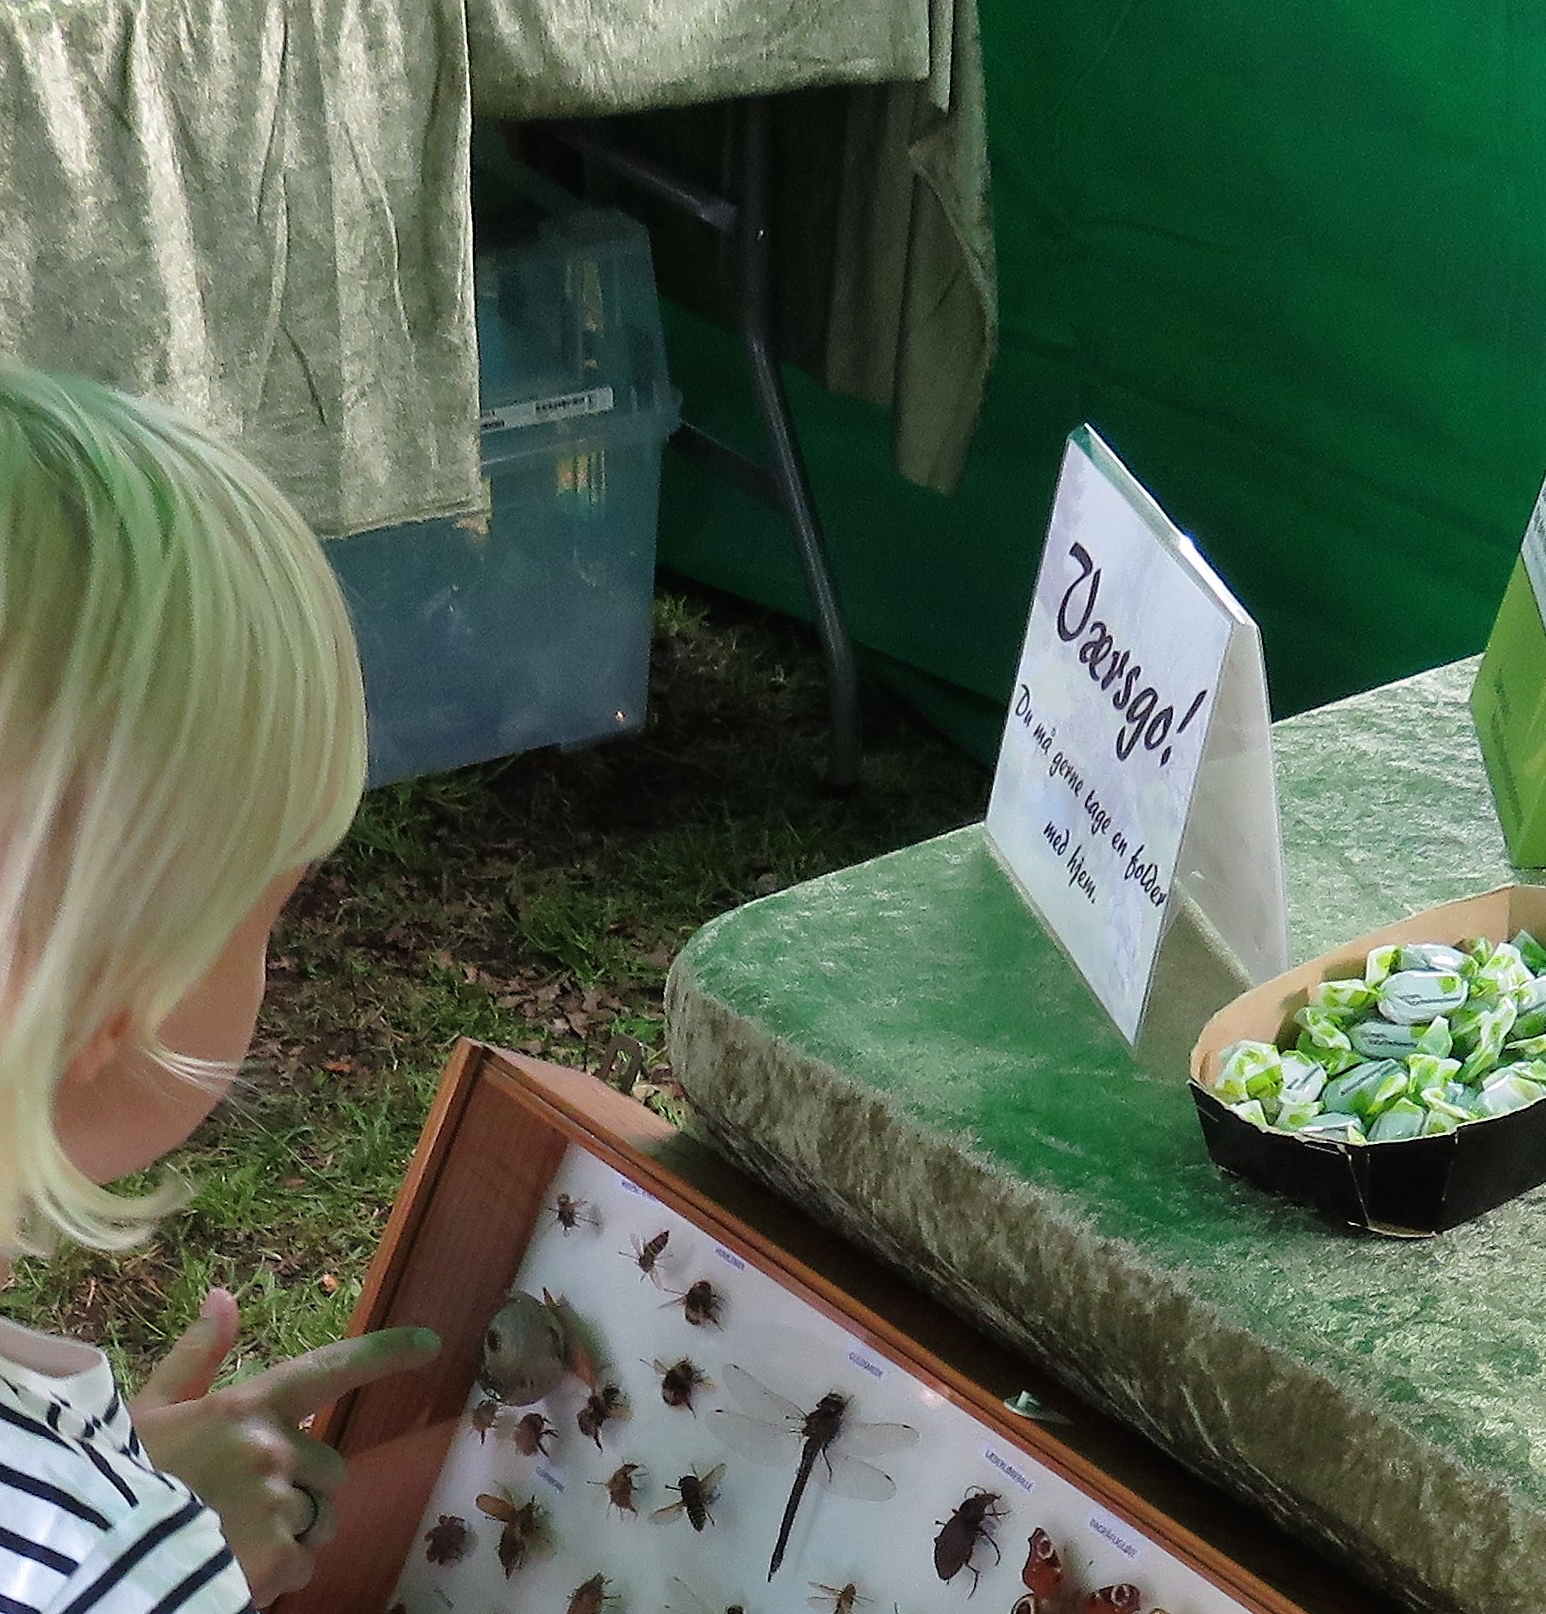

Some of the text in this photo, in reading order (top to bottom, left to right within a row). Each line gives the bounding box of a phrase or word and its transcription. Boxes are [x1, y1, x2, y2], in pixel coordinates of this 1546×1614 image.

[1057, 541, 1208, 767] Værsgo!
[1015, 684, 1168, 908] Du må gerne tage en folder
[1043, 820, 1097, 905] med hjem.
